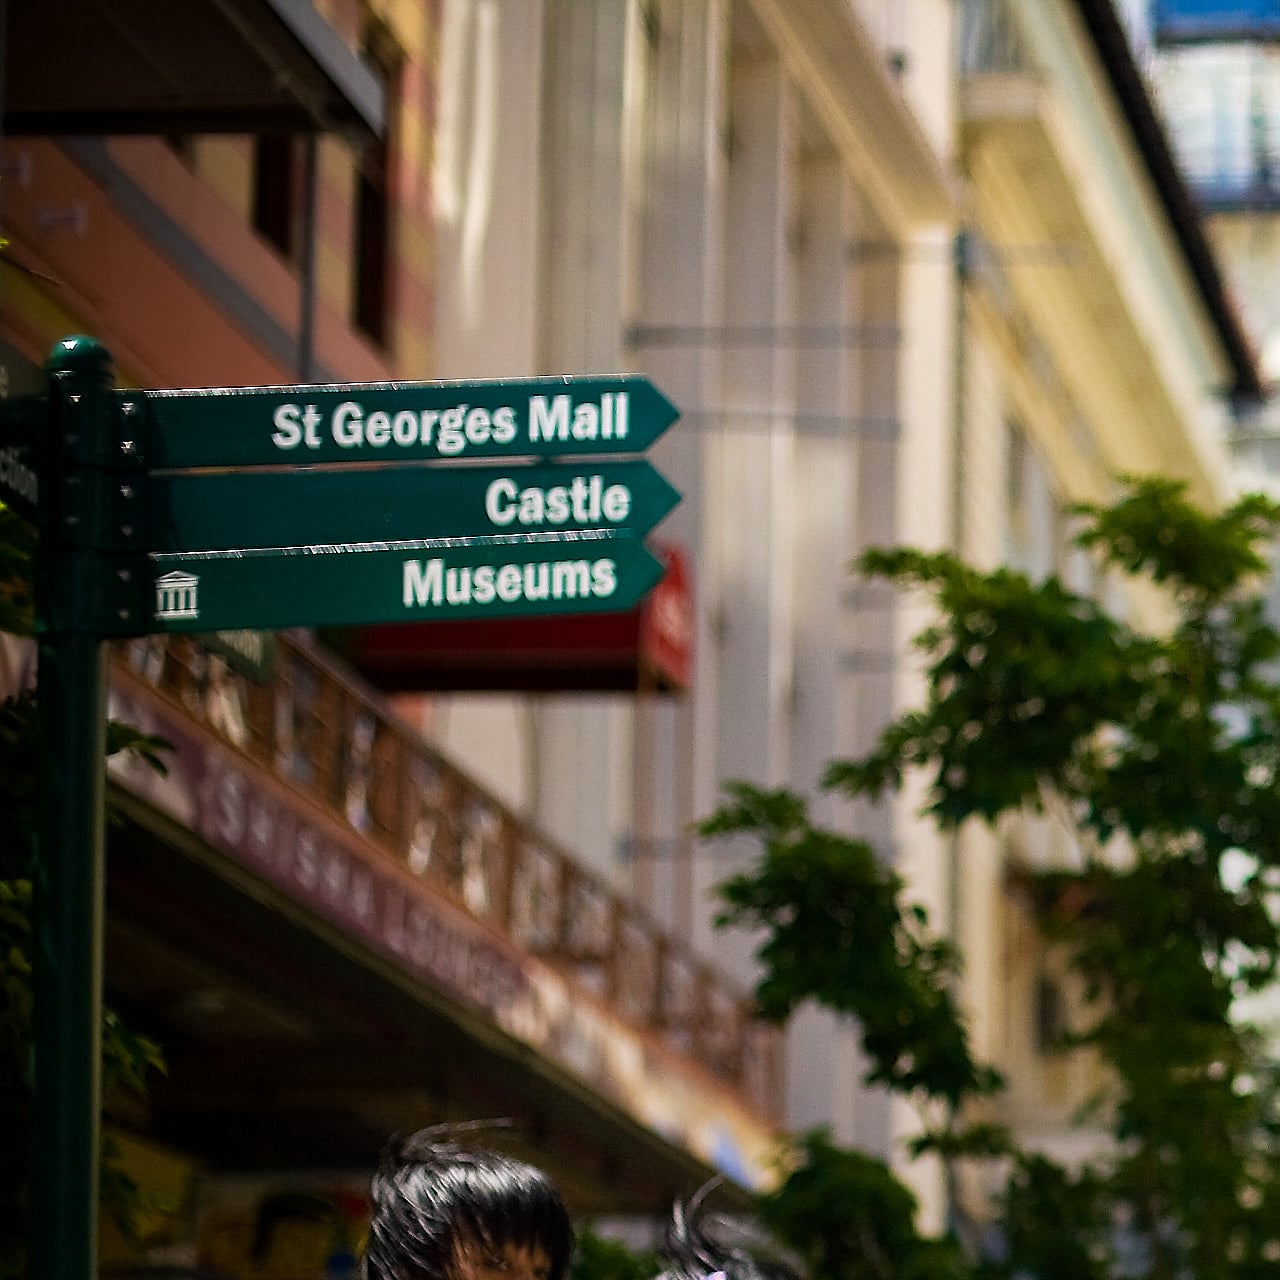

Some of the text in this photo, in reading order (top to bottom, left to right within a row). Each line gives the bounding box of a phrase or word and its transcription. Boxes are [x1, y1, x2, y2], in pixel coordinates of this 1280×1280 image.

[272, 391, 630, 456] St Georges Mall
[484, 474, 632, 526] Castle
[402, 558, 618, 609] Museums
